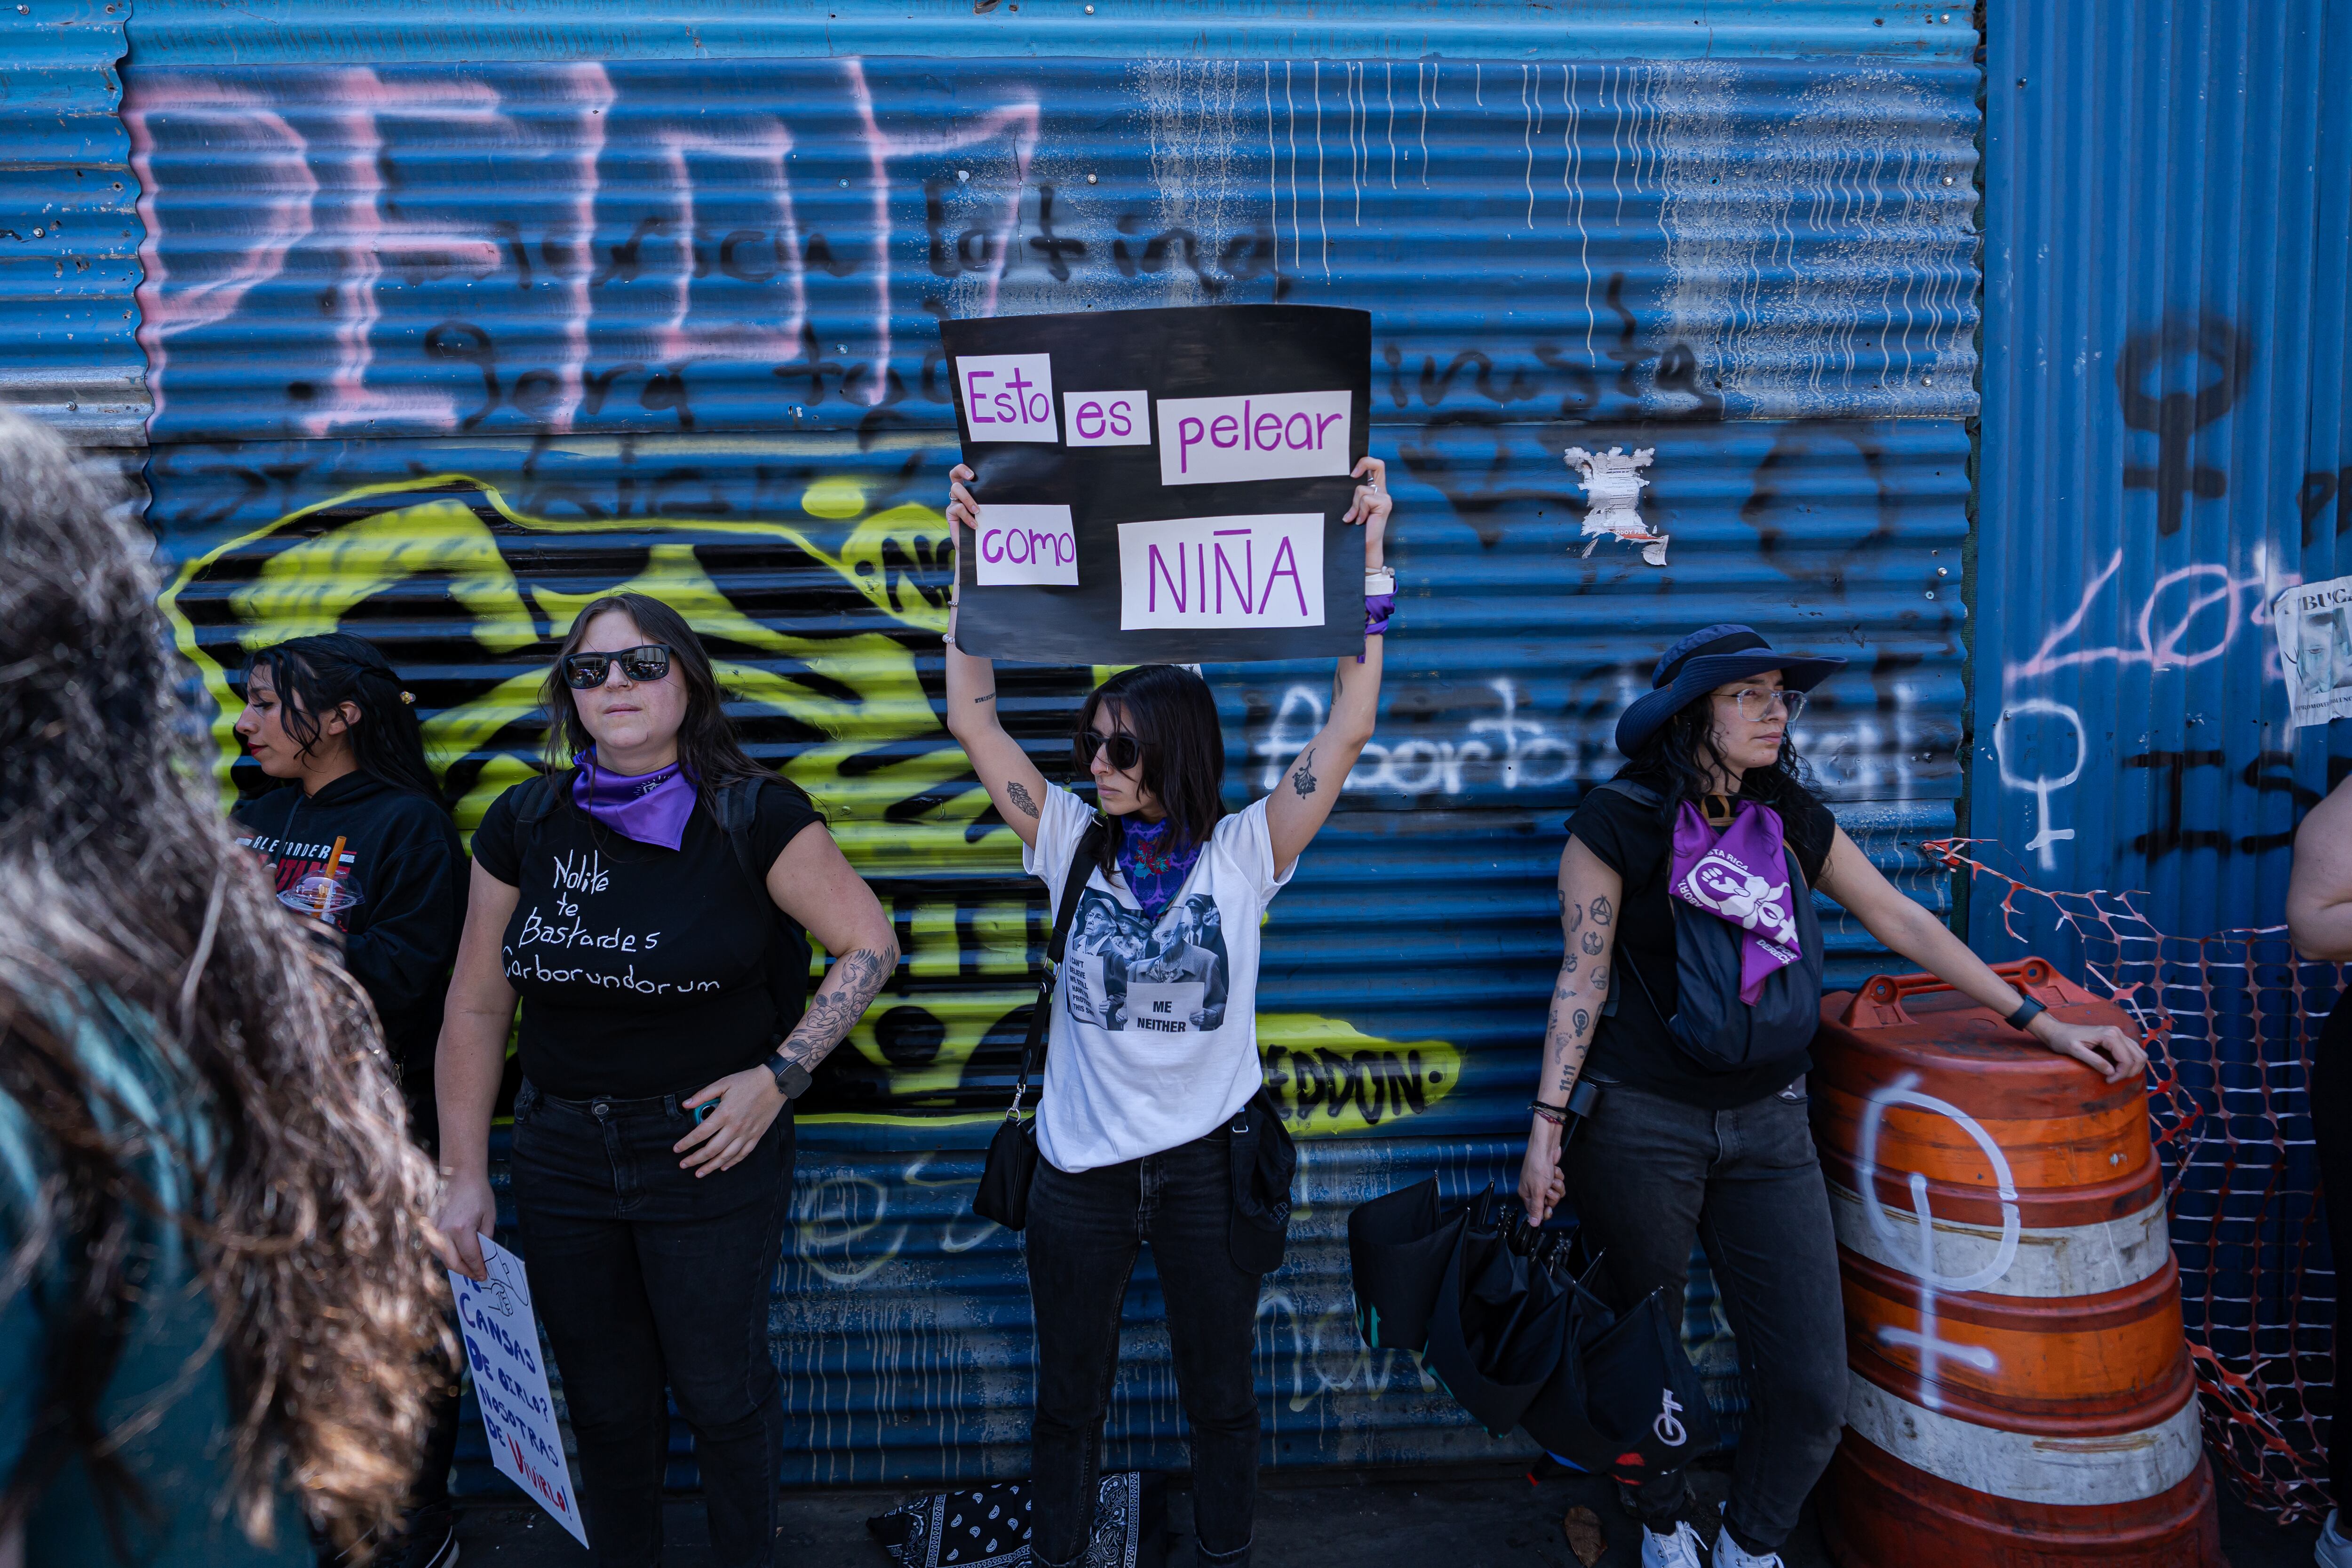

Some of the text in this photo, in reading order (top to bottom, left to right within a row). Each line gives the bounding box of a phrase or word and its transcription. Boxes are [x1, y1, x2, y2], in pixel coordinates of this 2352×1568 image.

[968, 367, 1343, 474] Esto es pelear
[982, 528, 1308, 616] como NIÑA
[252, 836, 331, 859] ALEANDER
[553, 849, 609, 894] Nolite
[1726, 854, 1749, 870] RICA
[556, 891, 578, 916] te
[1775, 945, 1798, 959] POR
[1072, 956, 1084, 968] CAN'T
[1069, 965, 1086, 979] BELIEVE
[1069, 974, 1089, 990] WE STILL
[1072, 985, 1084, 996] HAVE
[1073, 1003, 1085, 1012] THIS
[1152, 1001, 1172, 1013] ME
[1137, 1017, 1186, 1033] NEITHER
[459, 1292, 536, 1375] CANSAS
[465, 1334, 494, 1382] DE
[478, 1383, 559, 1468] NOSOTRAS
[484, 1412, 506, 1448] DE
